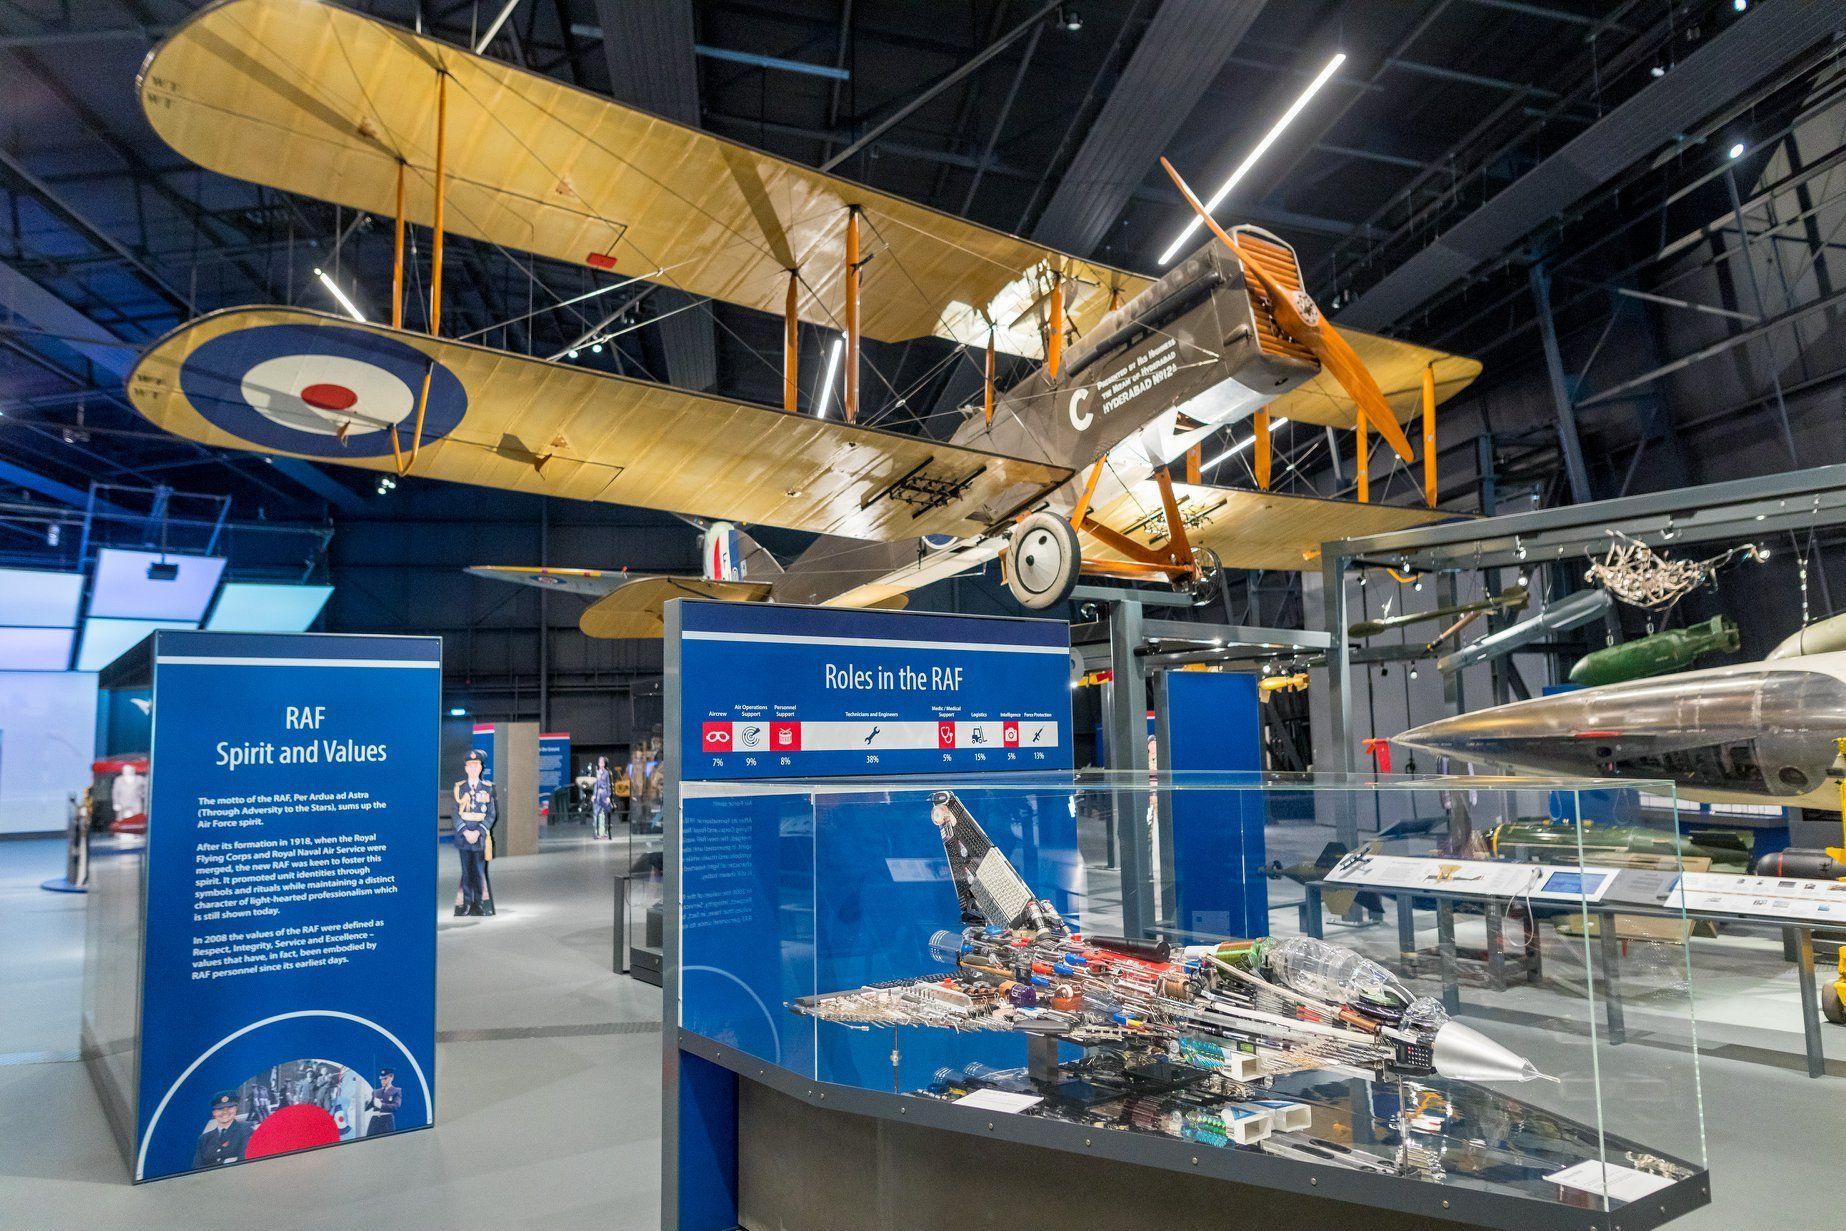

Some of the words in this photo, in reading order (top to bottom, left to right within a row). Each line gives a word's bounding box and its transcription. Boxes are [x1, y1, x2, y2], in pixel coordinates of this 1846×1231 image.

[1102, 378, 1153, 414] HYDERABAD
[1069, 388, 1094, 431] C
[825, 663, 874, 690] Roles
[878, 665, 894, 690] in
[898, 665, 928, 691] the
[932, 666, 963, 691] RAF
[285, 706, 326, 729] RAF
[216, 739, 274, 771] Spirit
[279, 739, 319, 764] and
[323, 739, 387, 763] Values
[712, 758, 724, 767] 7%
[746, 757, 757, 767] 9%
[780, 757, 791, 766] 8%
[866, 755, 879, 764] 38%
[943, 753, 952, 762] 5%
[974, 752, 987, 761] 15%
[1007, 752, 1017, 760] 5%
[198, 796, 216, 805] The
[217, 796, 245, 804] motto
[246, 794, 256, 803] of
[257, 794, 272, 803] the
[294, 793, 308, 802] Per
[309, 792, 335, 801] Ardua
[336, 791, 347, 800] ad
[348, 791, 369, 799] Astra
[242, 805, 283, 815] Adversity
[284, 805, 293, 813] to
[295, 804, 310, 813] the
[338, 803, 360, 811] sums
[361, 803, 372, 811] up
[373, 801, 387, 809] the
[197, 819, 212, 828] Air
[212, 819, 238, 827] Force
[197, 842, 220, 851] After
[221, 842, 233, 850] its
[234, 839, 278, 849] formation
[279, 838, 288, 846] in
[314, 835, 338, 844] when
[339, 834, 353, 843] the
[354, 832, 376, 843] Royal
[196, 854, 225, 864] Flying
[226, 852, 252, 862] Corps
[253, 850, 271, 859] and
[272, 848, 296, 859] Royal
[297, 847, 321, 857] Naval
[322, 846, 335, 855] Air
[336, 845, 366, 854] Service
[367, 844, 387, 852] were
[235, 863, 251, 872] the
[252, 863, 271, 871] new
[272, 860, 290, 870] RAF
[291, 860, 308, 868] was
[309, 858, 330, 867] keen
[331, 857, 341, 865] to
[342, 856, 366, 865] foster
[366, 854, 382, 863] this
[232, 872, 276, 886] promoted
[277, 871, 295, 880] unit
[296, 869, 336, 879] identities
[337, 865, 371, 876] through
[195, 887, 233, 899] symbols
[234, 885, 252, 895] and
[253, 883, 281, 894] rituals
[282, 881, 306, 891] while
[307, 878, 358, 889] maintaining
[365, 875, 395, 885] distinct
[194, 899, 238, 910] character
[239, 897, 249, 906] of
[250, 892, 307, 906] light-hearted
[308, 888, 373, 902] professionalism
[374, 884, 398, 894] which
[194, 913, 202, 921] is
[203, 911, 220, 920] still
[222, 910, 252, 919] shown
[193, 936, 203, 945] In
[204, 933, 228, 944] 2008
[229, 932, 245, 941] the
[246, 930, 274, 940] values
[275, 927, 286, 937] of
[286, 926, 301, 936] the
[302, 924, 319, 934] RAF
[321, 924, 342, 932] were
[342, 919, 374, 930] defined
[275, 938, 306, 948] Service
[307, 935, 324, 945] and
[325, 932, 368, 943] Excellence
[192, 958, 222, 968] values
[223, 955, 243, 965] that
[269, 952, 278, 960] in
[300, 948, 322, 957] been
[323, 942, 365, 954] embodied
[366, 941, 377, 951] by
[192, 970, 211, 980] RAF
[212, 964, 258, 979] personnel
[259, 964, 282, 972] since
[283, 962, 294, 970] its
[295, 958, 326, 968] earliest
